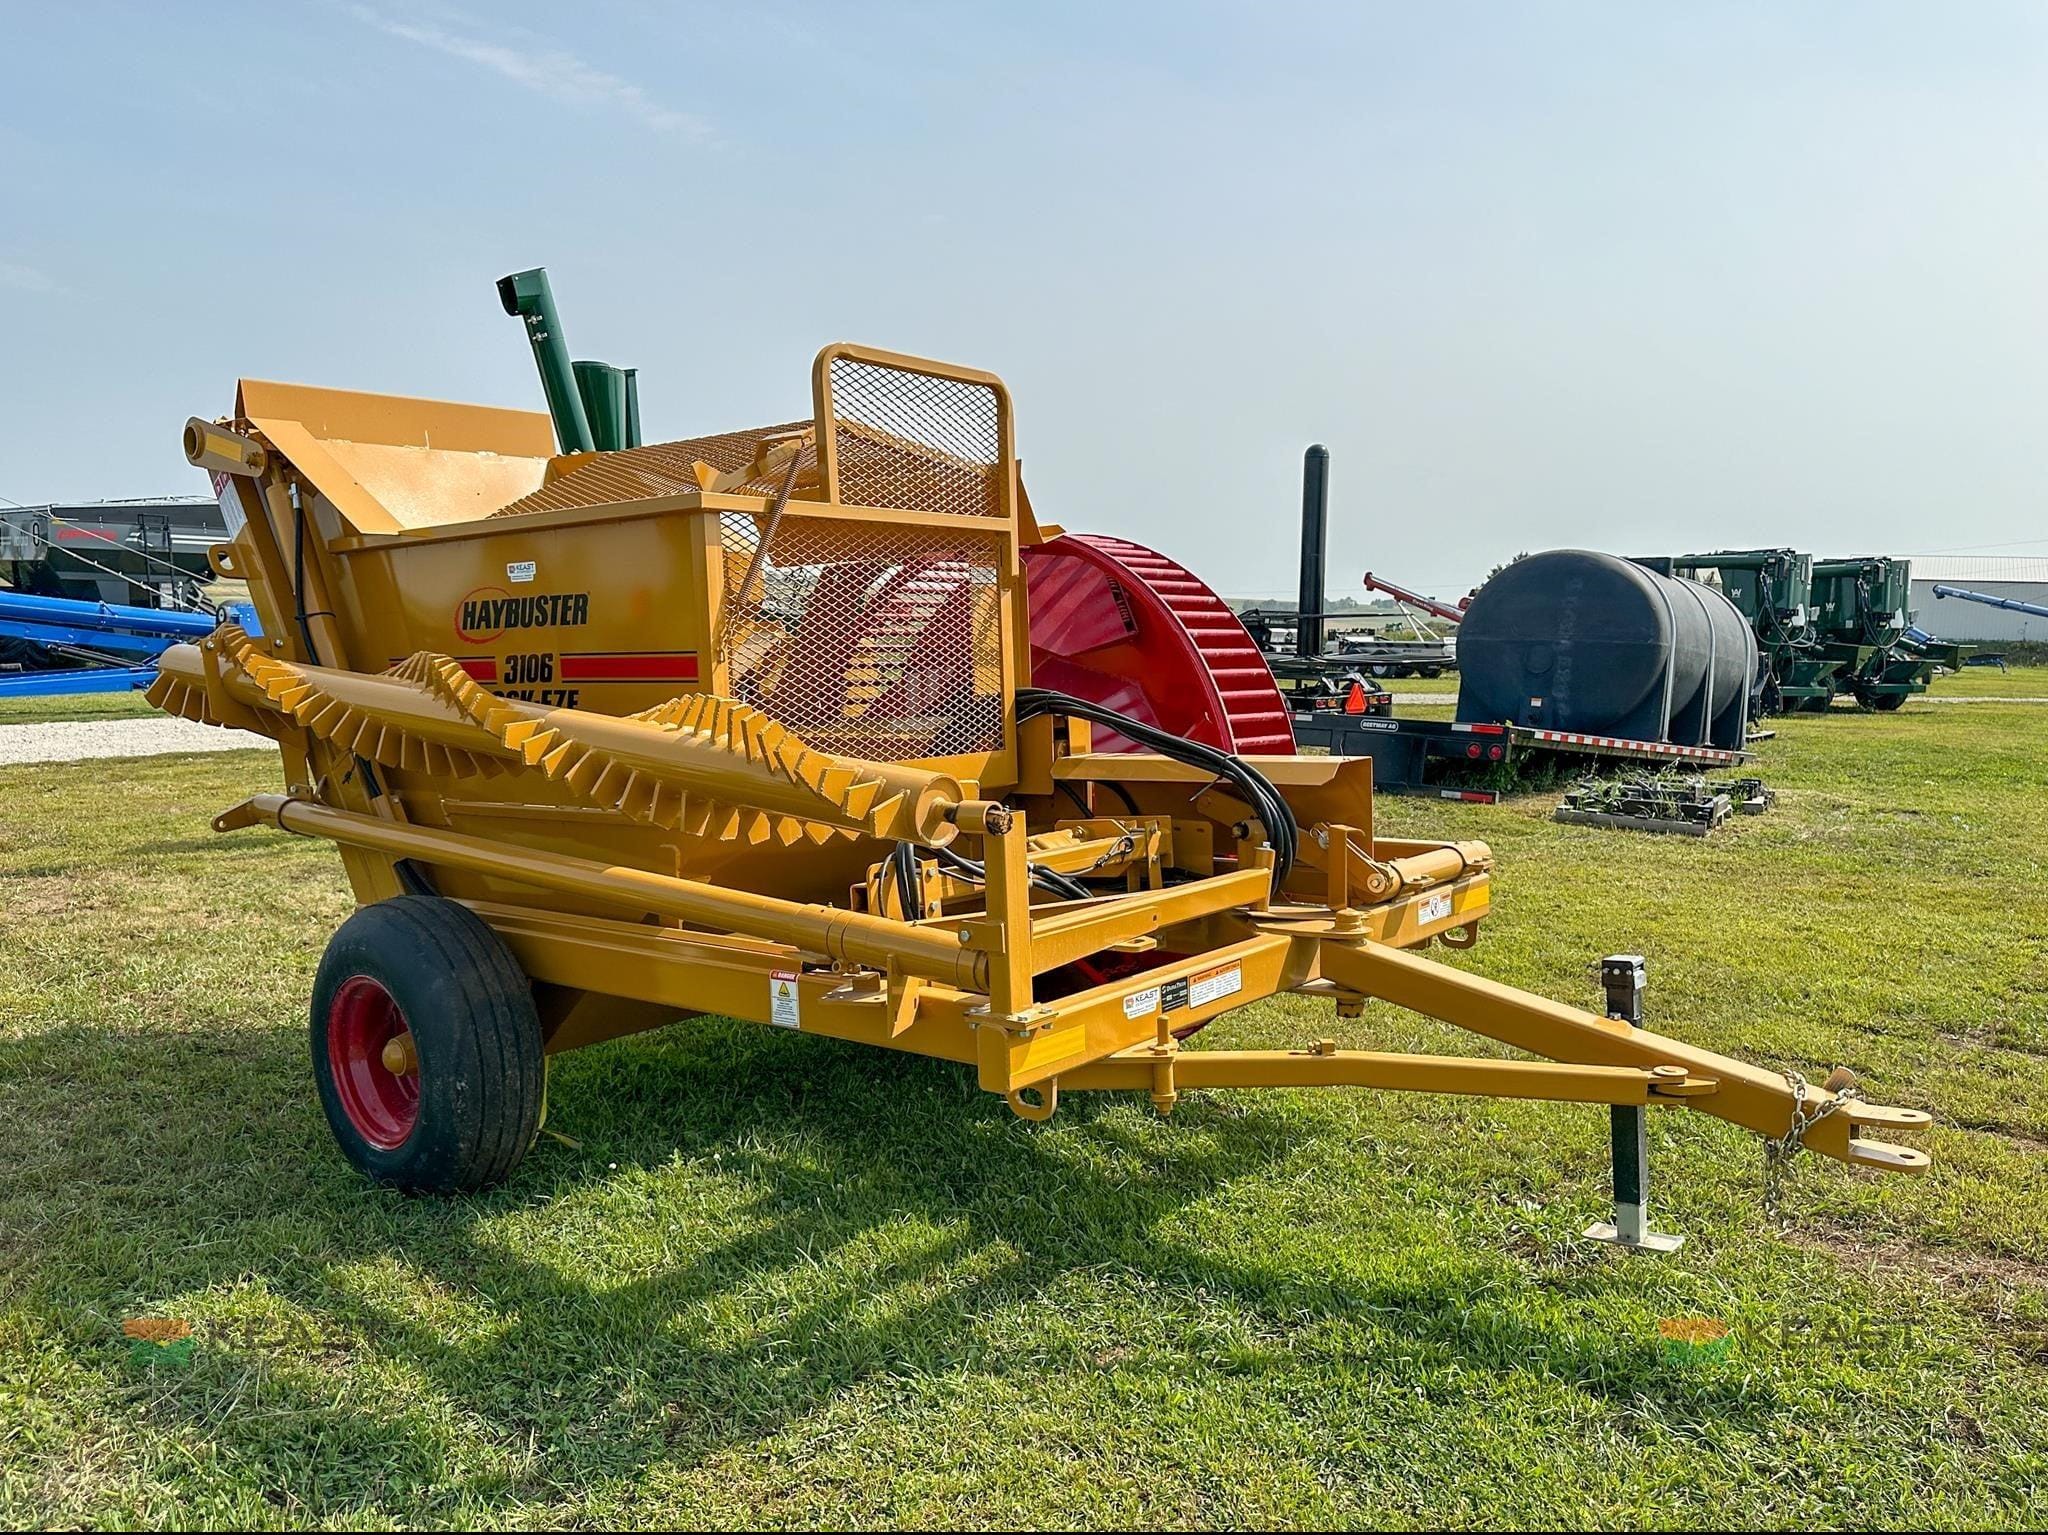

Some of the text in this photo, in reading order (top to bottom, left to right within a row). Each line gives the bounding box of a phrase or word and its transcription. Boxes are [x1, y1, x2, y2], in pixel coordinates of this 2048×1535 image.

[461, 593, 588, 631] HAYBUSTER
[503, 653, 553, 684] 3106
[1134, 988, 1158, 1003] KEAST
